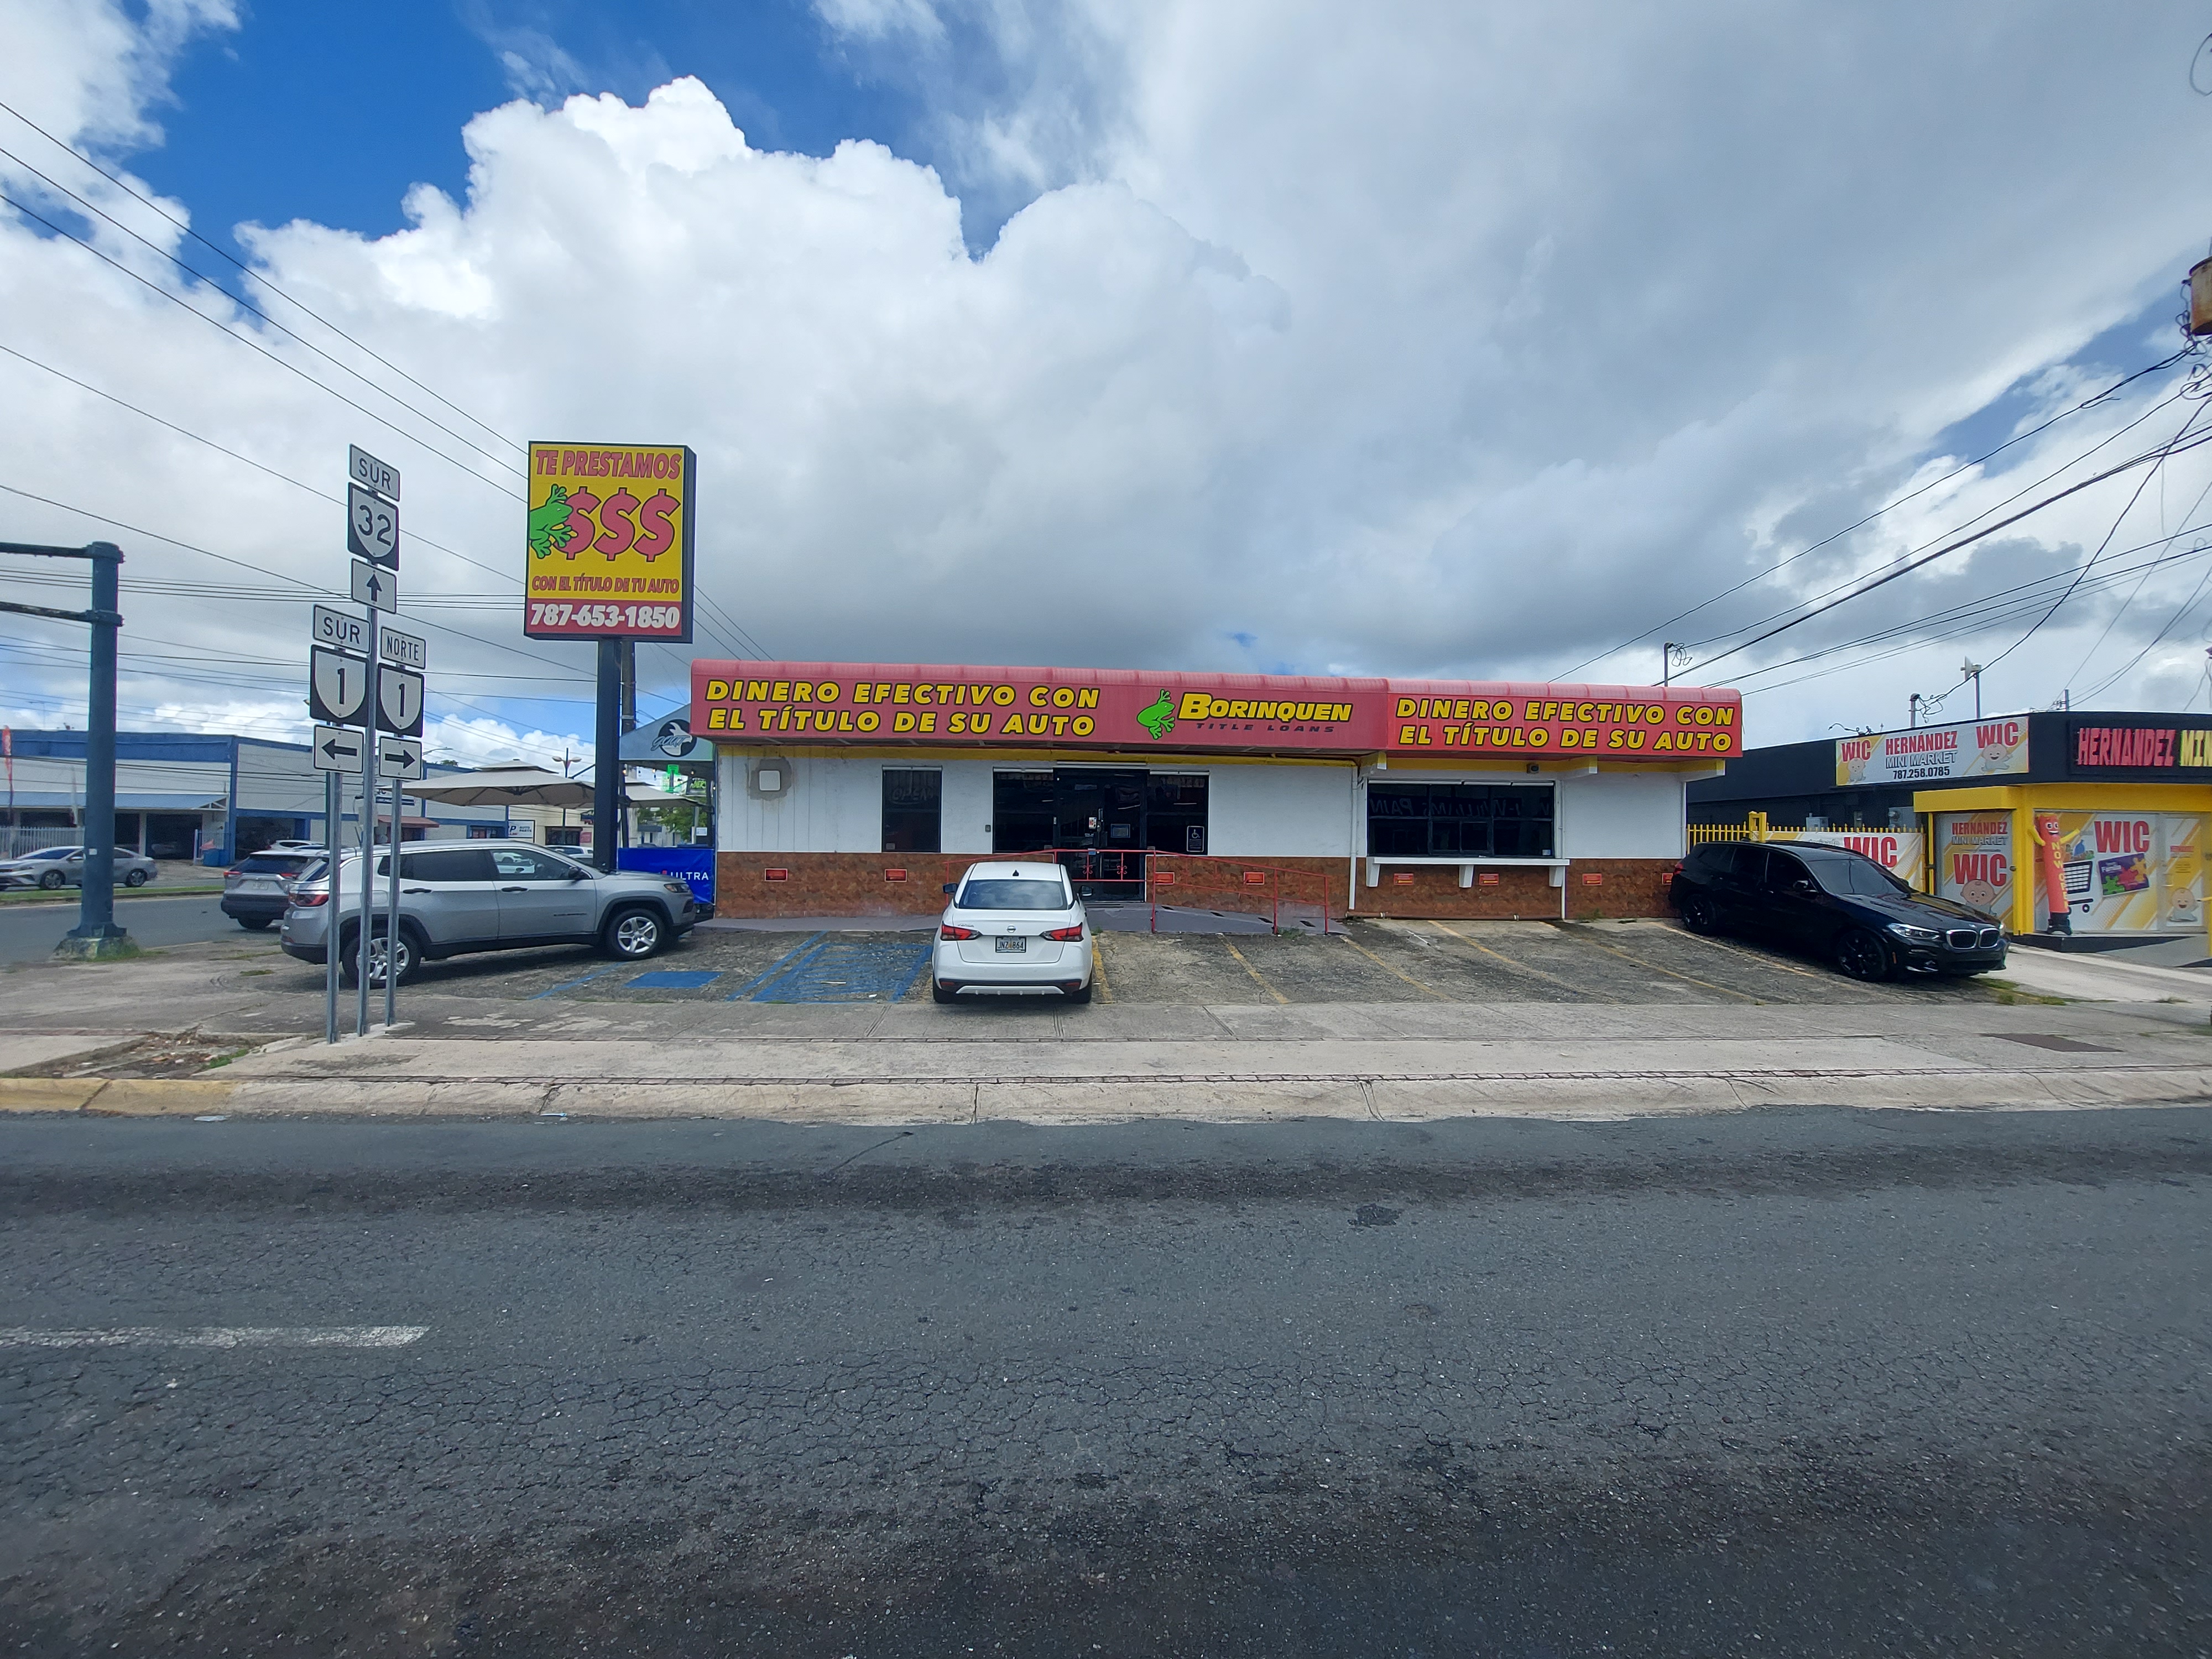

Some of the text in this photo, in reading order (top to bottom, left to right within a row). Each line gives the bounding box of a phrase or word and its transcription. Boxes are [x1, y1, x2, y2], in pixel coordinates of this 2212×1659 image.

[358, 457, 392, 491] SUR
[536, 450, 682, 479] TE PRESTAMOS
[357, 504, 392, 546] 32
[532, 573, 680, 593] CON EL TÍTULO DE TU AUTO
[530, 603, 680, 629] 787-653-1850
[323, 617, 360, 645] SUR
[387, 635, 419, 662] NORTE
[337, 667, 345, 705] 1
[398, 682, 405, 717] 1
[706, 680, 1100, 708] DINERO EFECTIVO CON
[708, 705, 1095, 737] EL TÍTULO DE SU AUTO
[1178, 692, 1353, 722] BORINQUEN
[1396, 698, 1734, 726] DINERO EFECTIVO CON
[1399, 721, 1732, 752] EL TÍTULO DE SU AUTO
[1886, 731, 1958, 755] HERNÁNDEZ
[1975, 722, 2019, 749] WIC
[2077, 728, 2176, 766] HERNANDEZ
[1841, 740, 1871, 762] WIC
[1886, 750, 1958, 769] MINI MARKET
[1893, 766, 1950, 780] 787.258.0785
[2095, 821, 2150, 853] WIC
[1953, 853, 2007, 887] WIC
